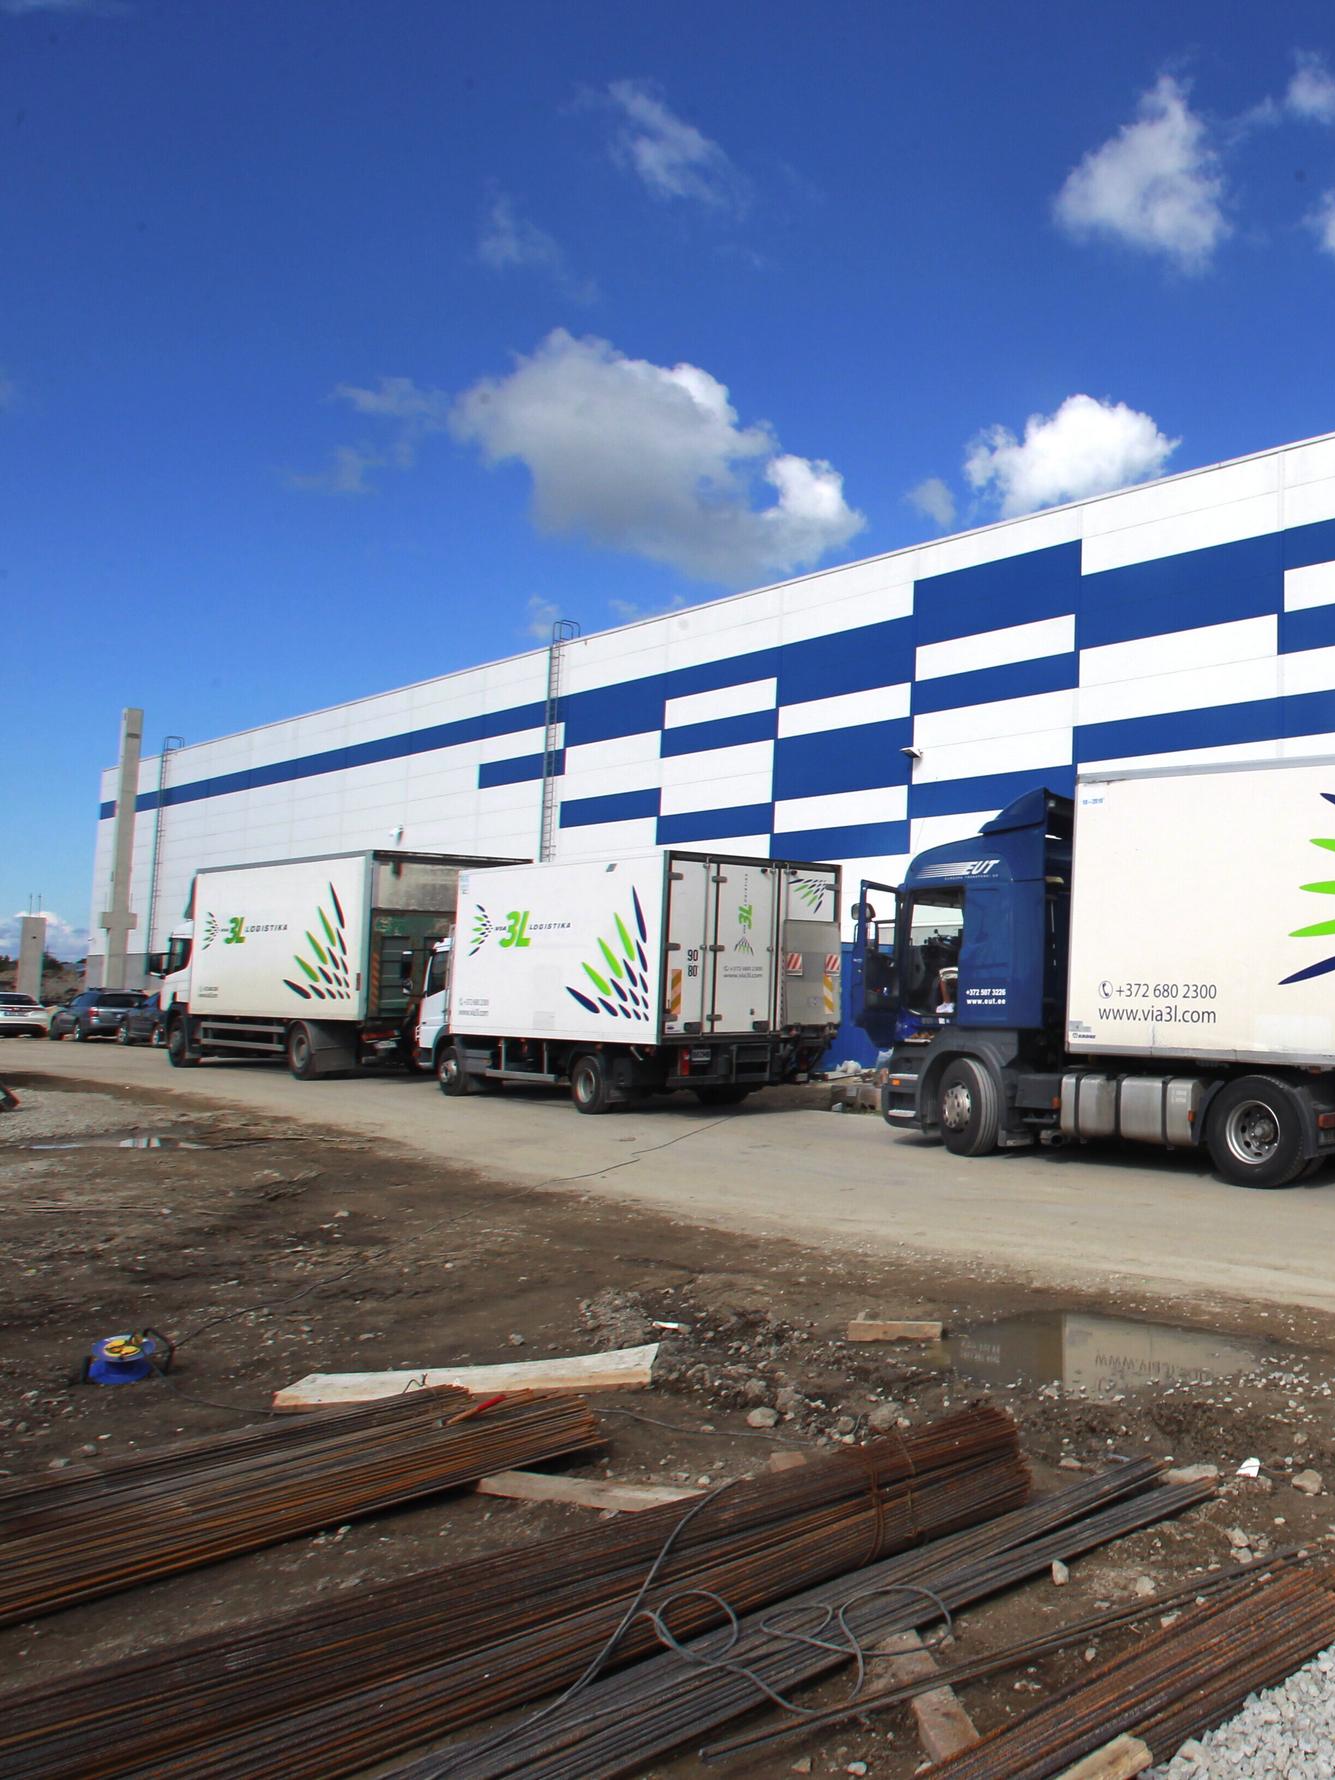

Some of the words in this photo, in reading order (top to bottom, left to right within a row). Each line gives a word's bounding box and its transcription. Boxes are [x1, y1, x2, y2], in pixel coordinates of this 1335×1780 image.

[245, 924, 288, 933] LOGISTIKA
[499, 911, 531, 948] 3L
[529, 922, 571, 931] LOGISTIKA
[687, 949, 698, 961] 90
[687, 965, 698, 977] 80
[966, 988, 980, 996] +372
[1116, 983, 1149, 998] +372
[1153, 983, 1179, 998] 680
[1182, 984, 1217, 999] 2300
[1098, 1004, 1217, 1023] www.via3l.com
